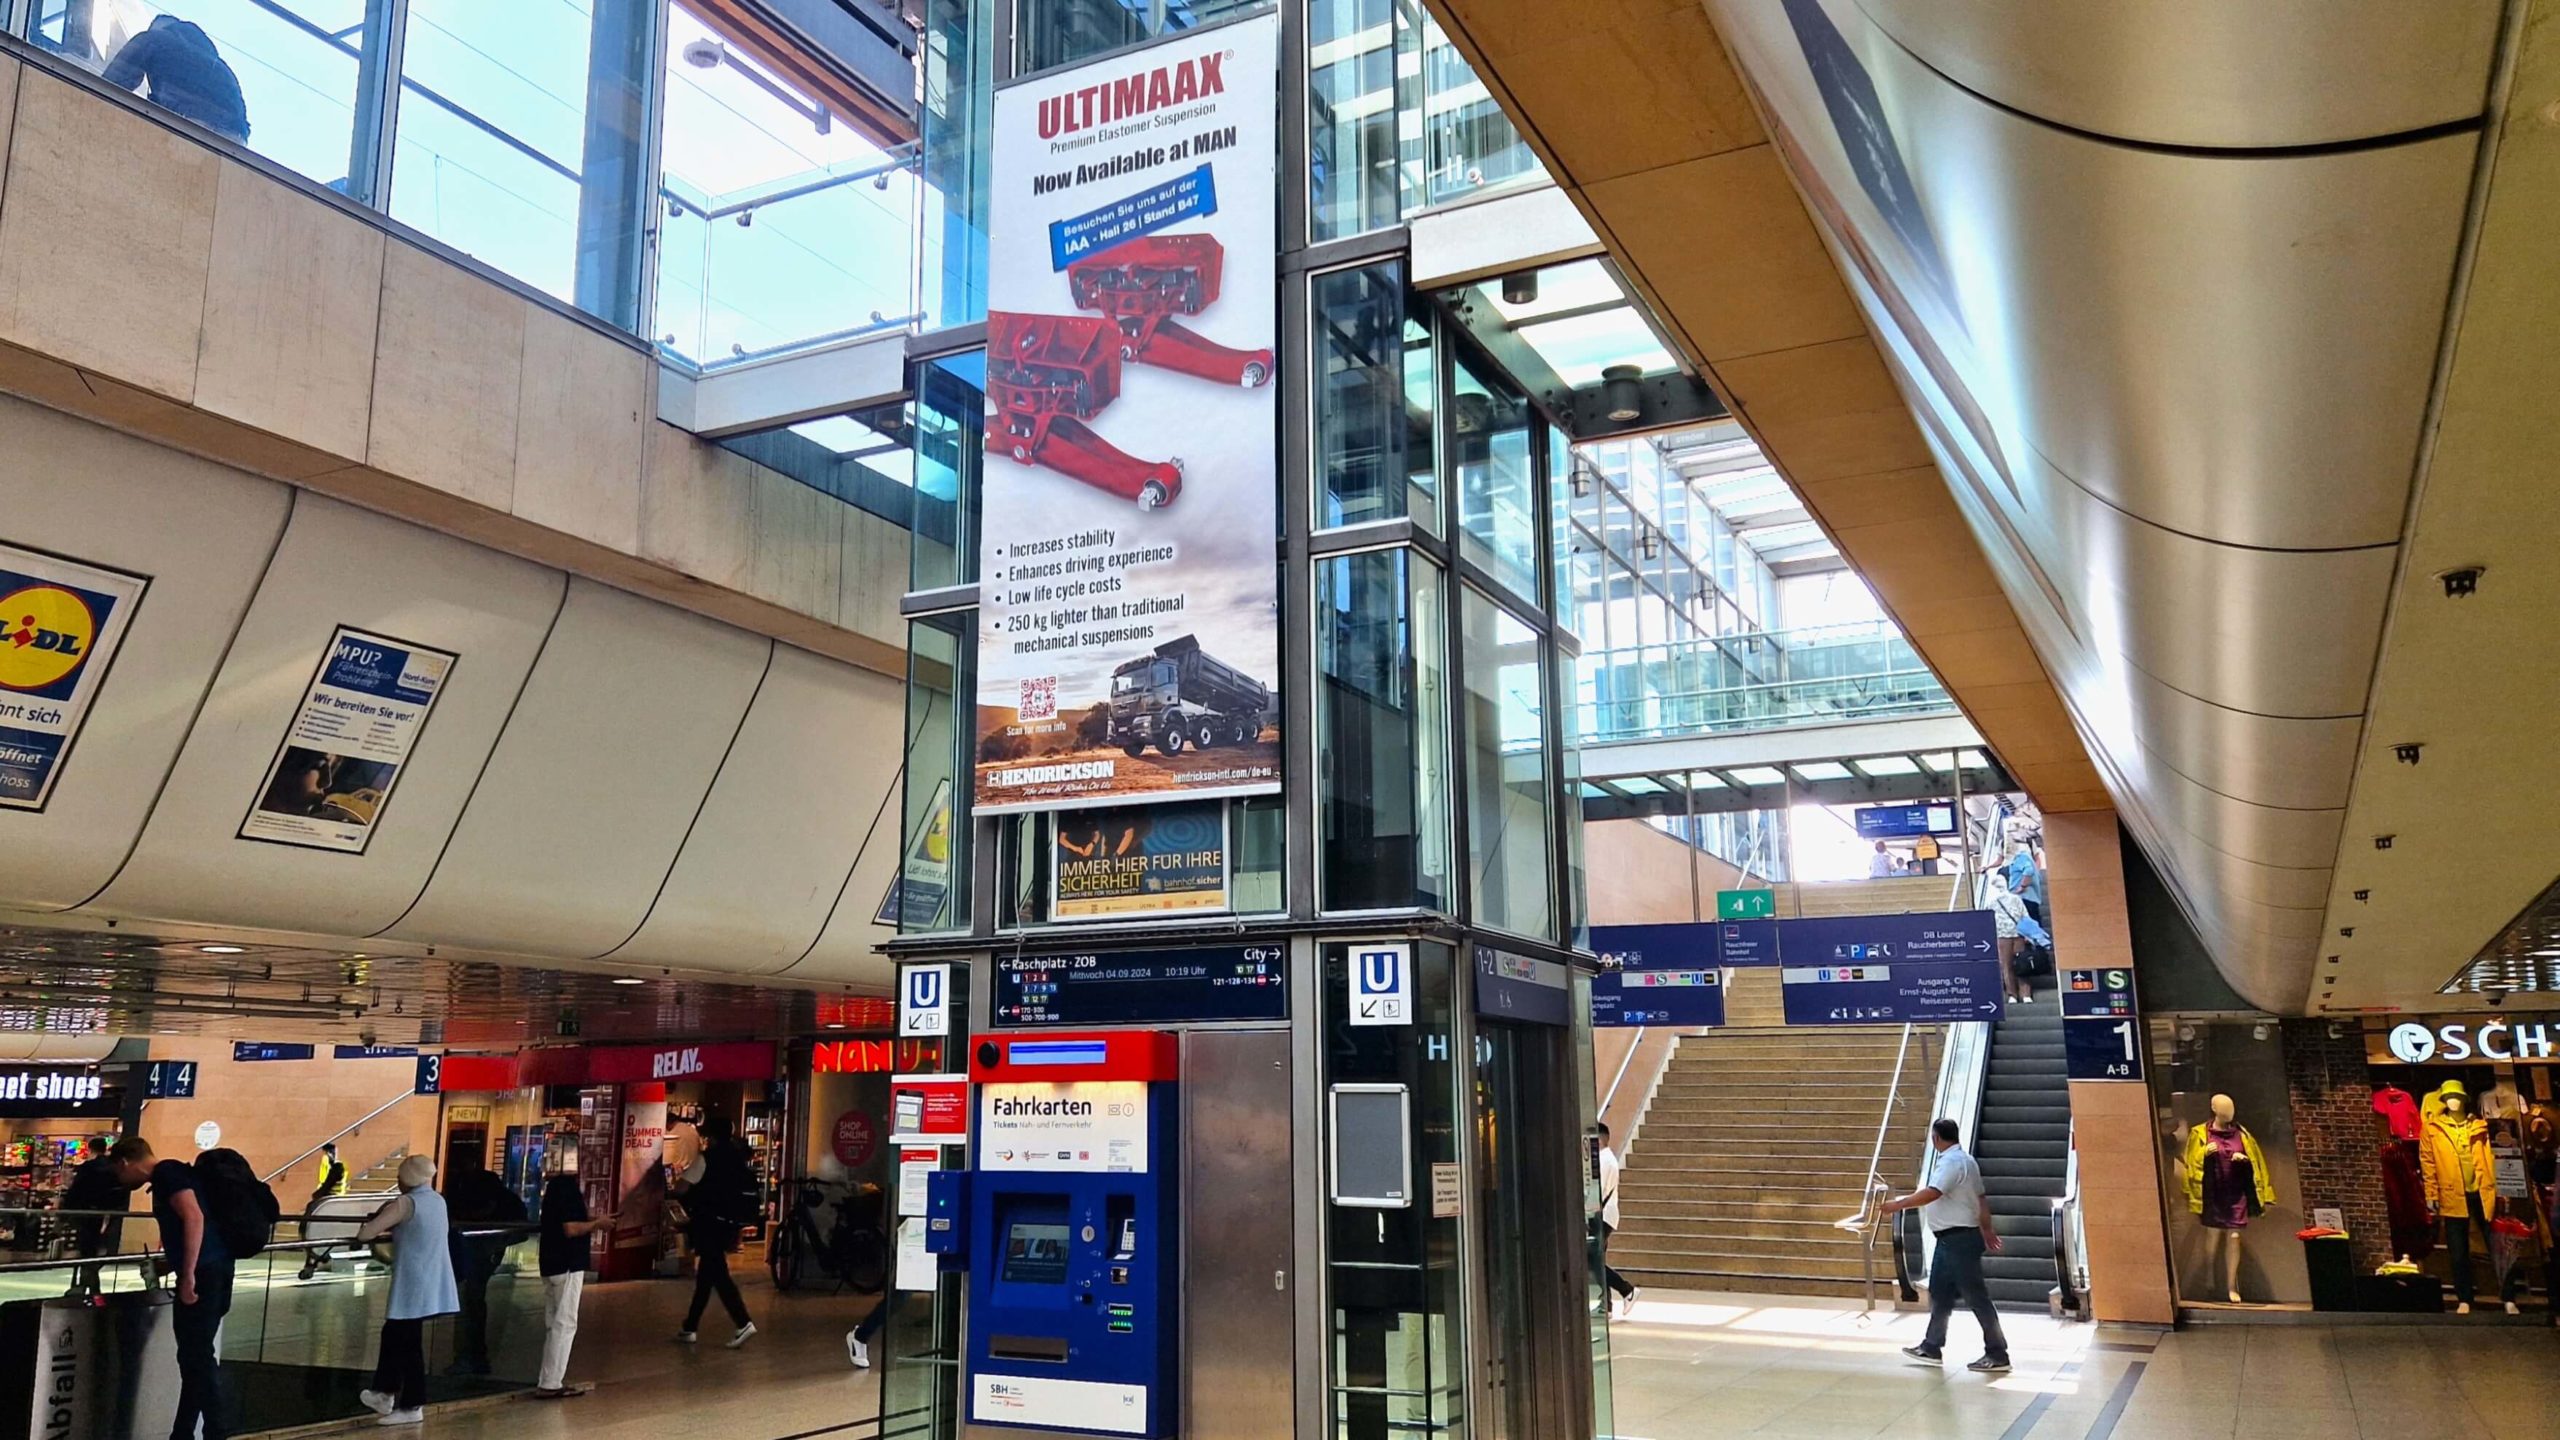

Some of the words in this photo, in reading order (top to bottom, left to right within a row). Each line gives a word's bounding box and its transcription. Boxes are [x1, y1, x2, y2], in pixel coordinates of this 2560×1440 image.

[1050, 133, 1096, 154] Premium
[1099, 119, 1151, 143] Elastomer
[1154, 102, 1217, 128] Suspension
[1033, 173, 1072, 196] Now
[1076, 147, 1165, 186] Available
[1169, 142, 1189, 155] at
[1194, 126, 1237, 155] MAN
[1063, 211, 1115, 237] Besuchen
[1118, 203, 1134, 218] Sie
[1137, 196, 1157, 209] uns
[1159, 187, 1177, 201] auf
[1179, 179, 1197, 196] der
[1065, 237, 1090, 255] IAA
[1100, 227, 1120, 242] Hall
[1122, 219, 1137, 231] 26
[1144, 206, 1176, 224] Stand
[1178, 194, 1200, 211] B47
[1009, 537, 1064, 559] Increases
[1067, 529, 1116, 550] stability
[1009, 560, 1062, 582] Enhances
[1065, 554, 1105, 574] driving
[1108, 545, 1174, 570] experience
[1008, 589, 1031, 606] Low
[1034, 583, 1052, 601] life
[1055, 580, 1085, 602] cycle
[1089, 576, 1122, 594] costs
[1008, 614, 1031, 632] 250
[1034, 612, 1048, 632] kg
[1050, 606, 1087, 629] lighter
[1091, 603, 1118, 622] than
[1122, 594, 1185, 618] traditional
[1014, 631, 1078, 655] mechanical
[1081, 624, 1154, 650] suspensions
[334, 643, 382, 667] MPU?
[27, 707, 61, 725] sich
[313, 692, 333, 706] Wir
[334, 696, 376, 715] bereiten
[378, 706, 393, 718] Sie
[395, 711, 415, 723] vor!
[1006, 725, 1023, 737] Scan
[1025, 725, 1034, 735] for
[1035, 724, 1052, 734] more
[1053, 721, 1067, 732] info
[1002, 760, 1115, 786] HENDRICKSON
[1173, 766, 1272, 784] hendrickson-intl.com/de-eu
[1060, 859, 1111, 877] IMMER
[1115, 856, 1149, 873] HIER
[1153, 852, 1182, 870] FÜR
[1186, 851, 1221, 868] IHRE
[1060, 871, 1143, 893] SICHERHEIT
[1012, 957, 1067, 973] Raschplatz
[1074, 956, 1097, 968] ZOB
[1244, 948, 1267, 963] City
[1070, 970, 1104, 980] Mittwoch
[1106, 968, 1151, 979] 04.09.2024
[1165, 967, 1189, 976] 10:19
[1190, 966, 1206, 975] Uhr
[1366, 954, 1393, 992] U
[1954, 977, 1969, 985] City
[2107, 970, 2125, 989] S
[914, 973, 936, 1006] U
[1900, 987, 1970, 996] Ernst-August-Platz
[2113, 1020, 2133, 1061] 1
[2440, 1023, 2560, 1061] SCH
[150, 1063, 160, 1087] 4
[177, 1063, 191, 1087] 4
[426, 1056, 439, 1082] 3
[2106, 1064, 2129, 1075] A-B
[35, 1072, 100, 1099] shoes
[456, 1109, 478, 1120] NEW
[993, 1096, 1092, 1116] Fahrkarten
[625, 1127, 662, 1138] SUMMER
[840, 1121, 861, 1130] SHOP
[840, 1130, 869, 1140] ONLINE
[993, 1120, 1018, 1129] Tickets
[625, 1139, 652, 1149] DEALS
[990, 1384, 1008, 1394] SBH
